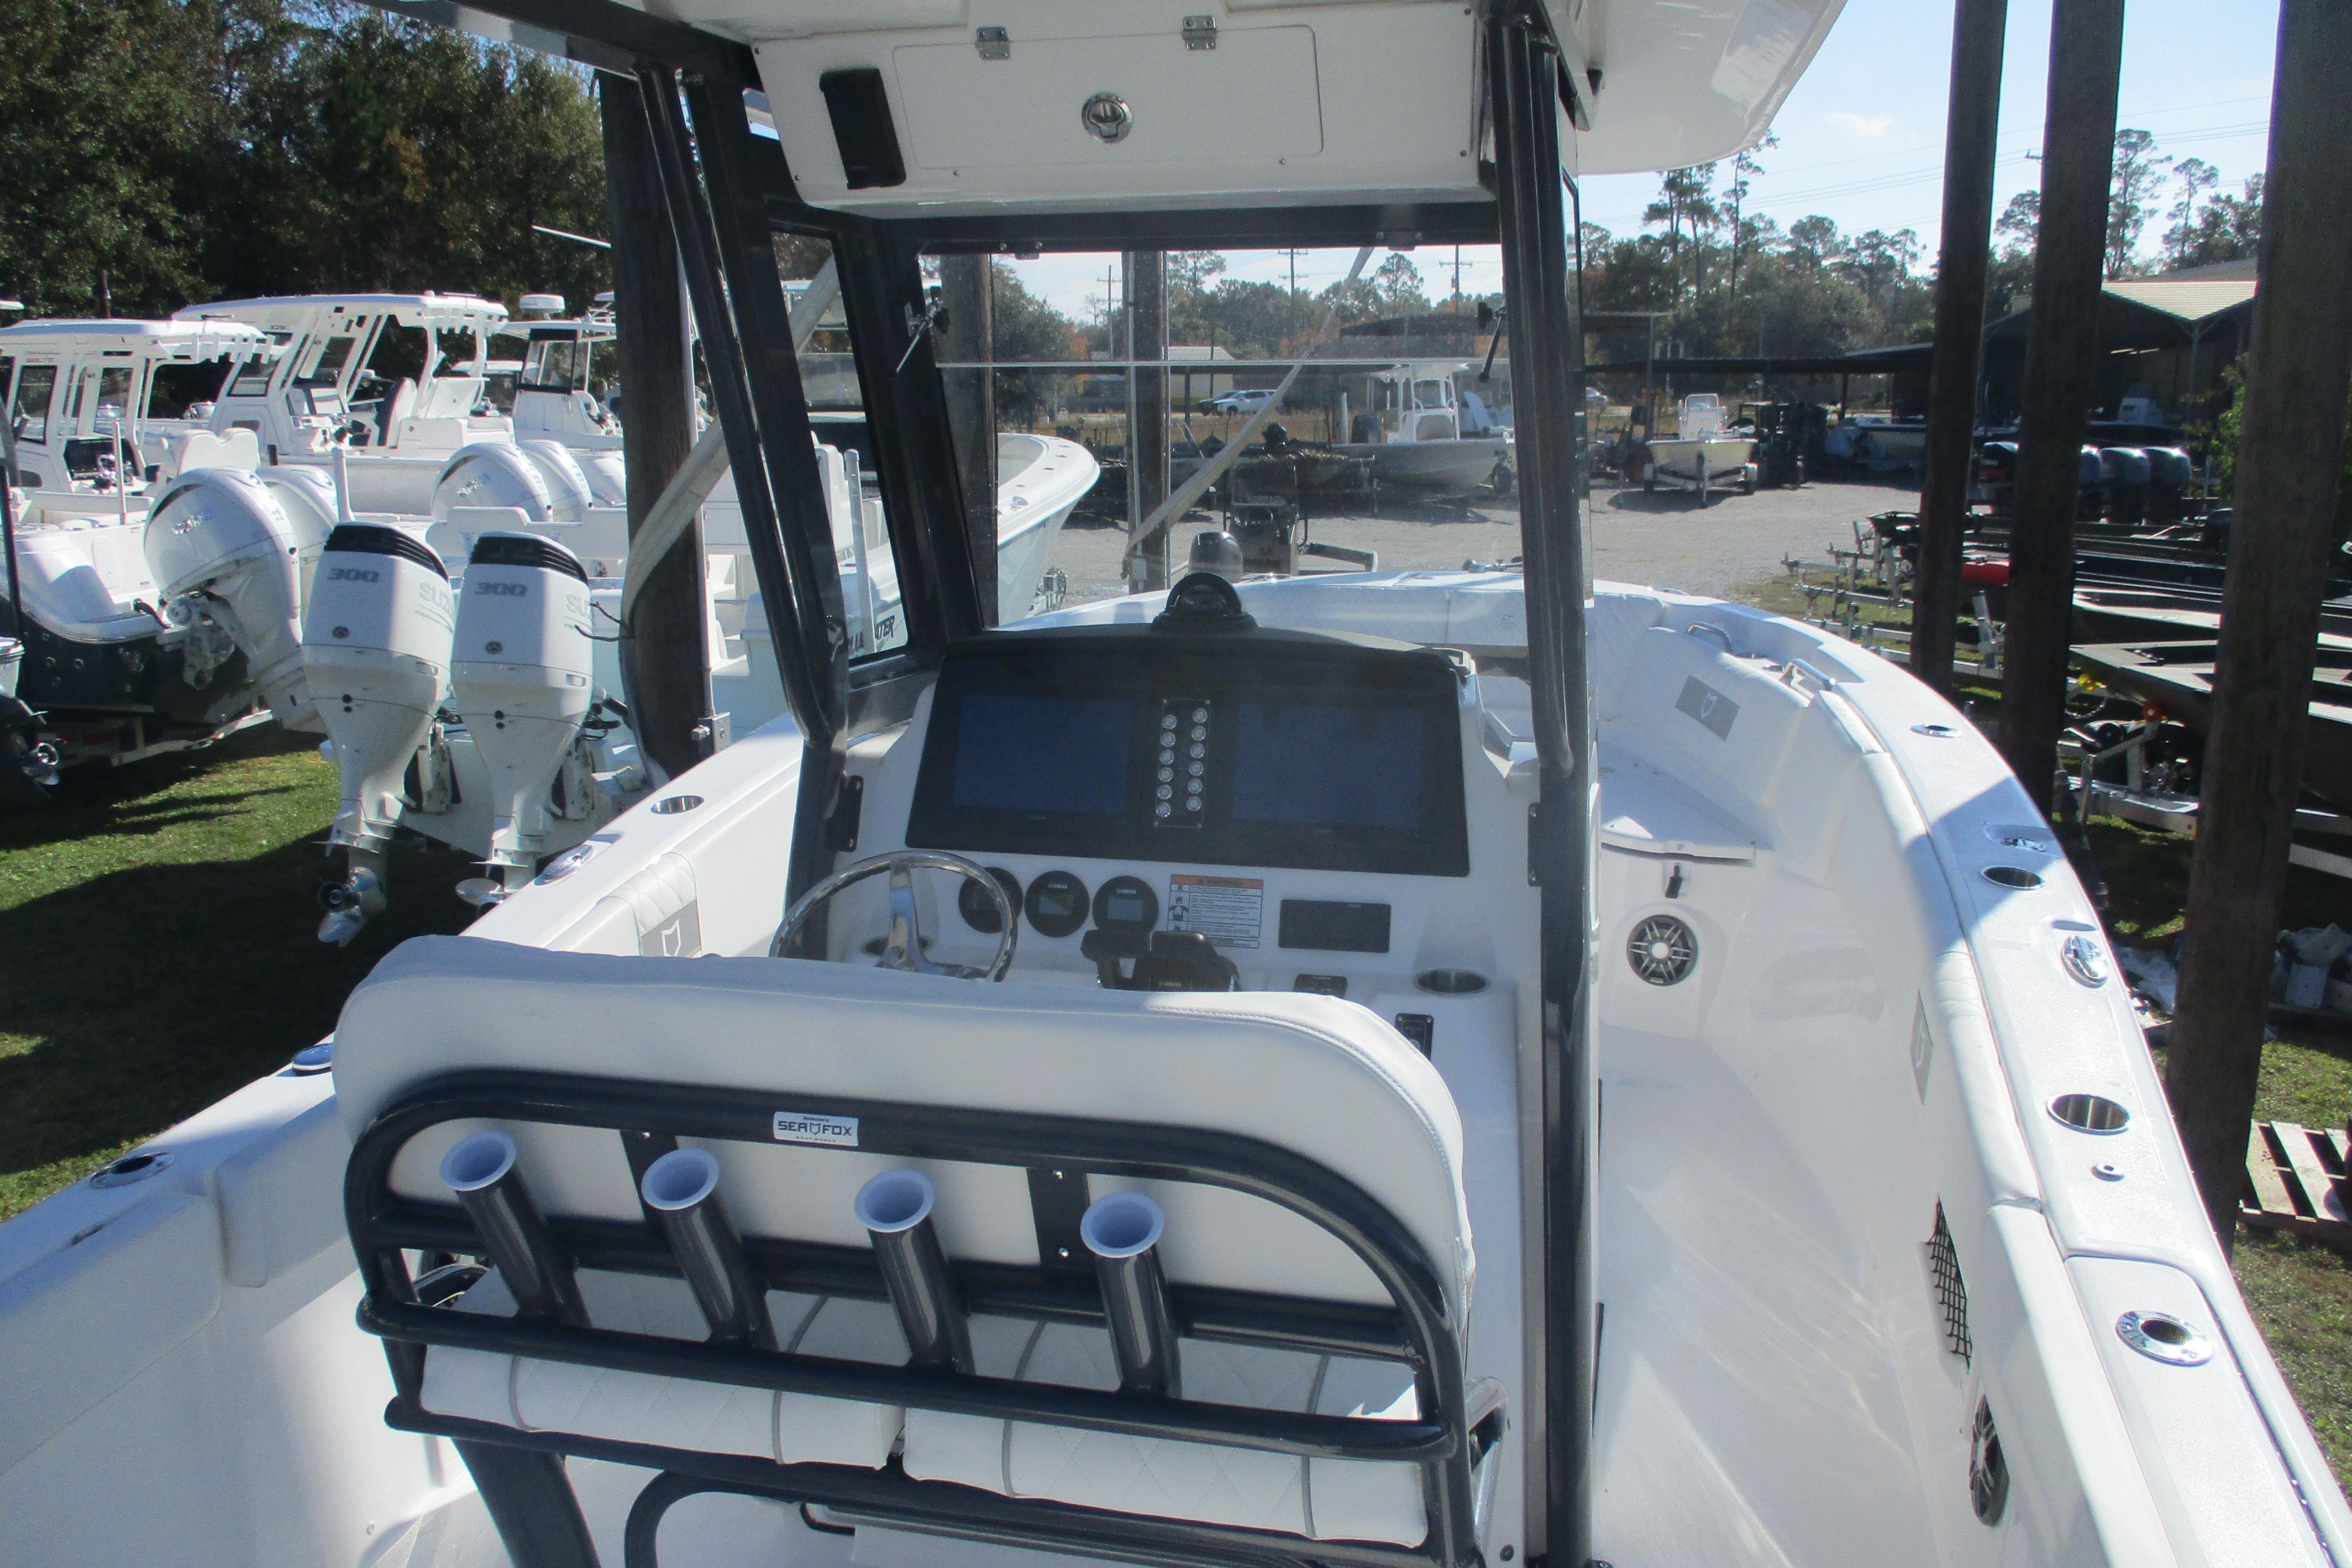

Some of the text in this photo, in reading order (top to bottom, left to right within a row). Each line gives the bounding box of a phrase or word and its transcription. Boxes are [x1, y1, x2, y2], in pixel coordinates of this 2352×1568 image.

[328, 568, 379, 582] 300
[475, 582, 528, 597] 300
[778, 1121, 852, 1136] SEA FOX
